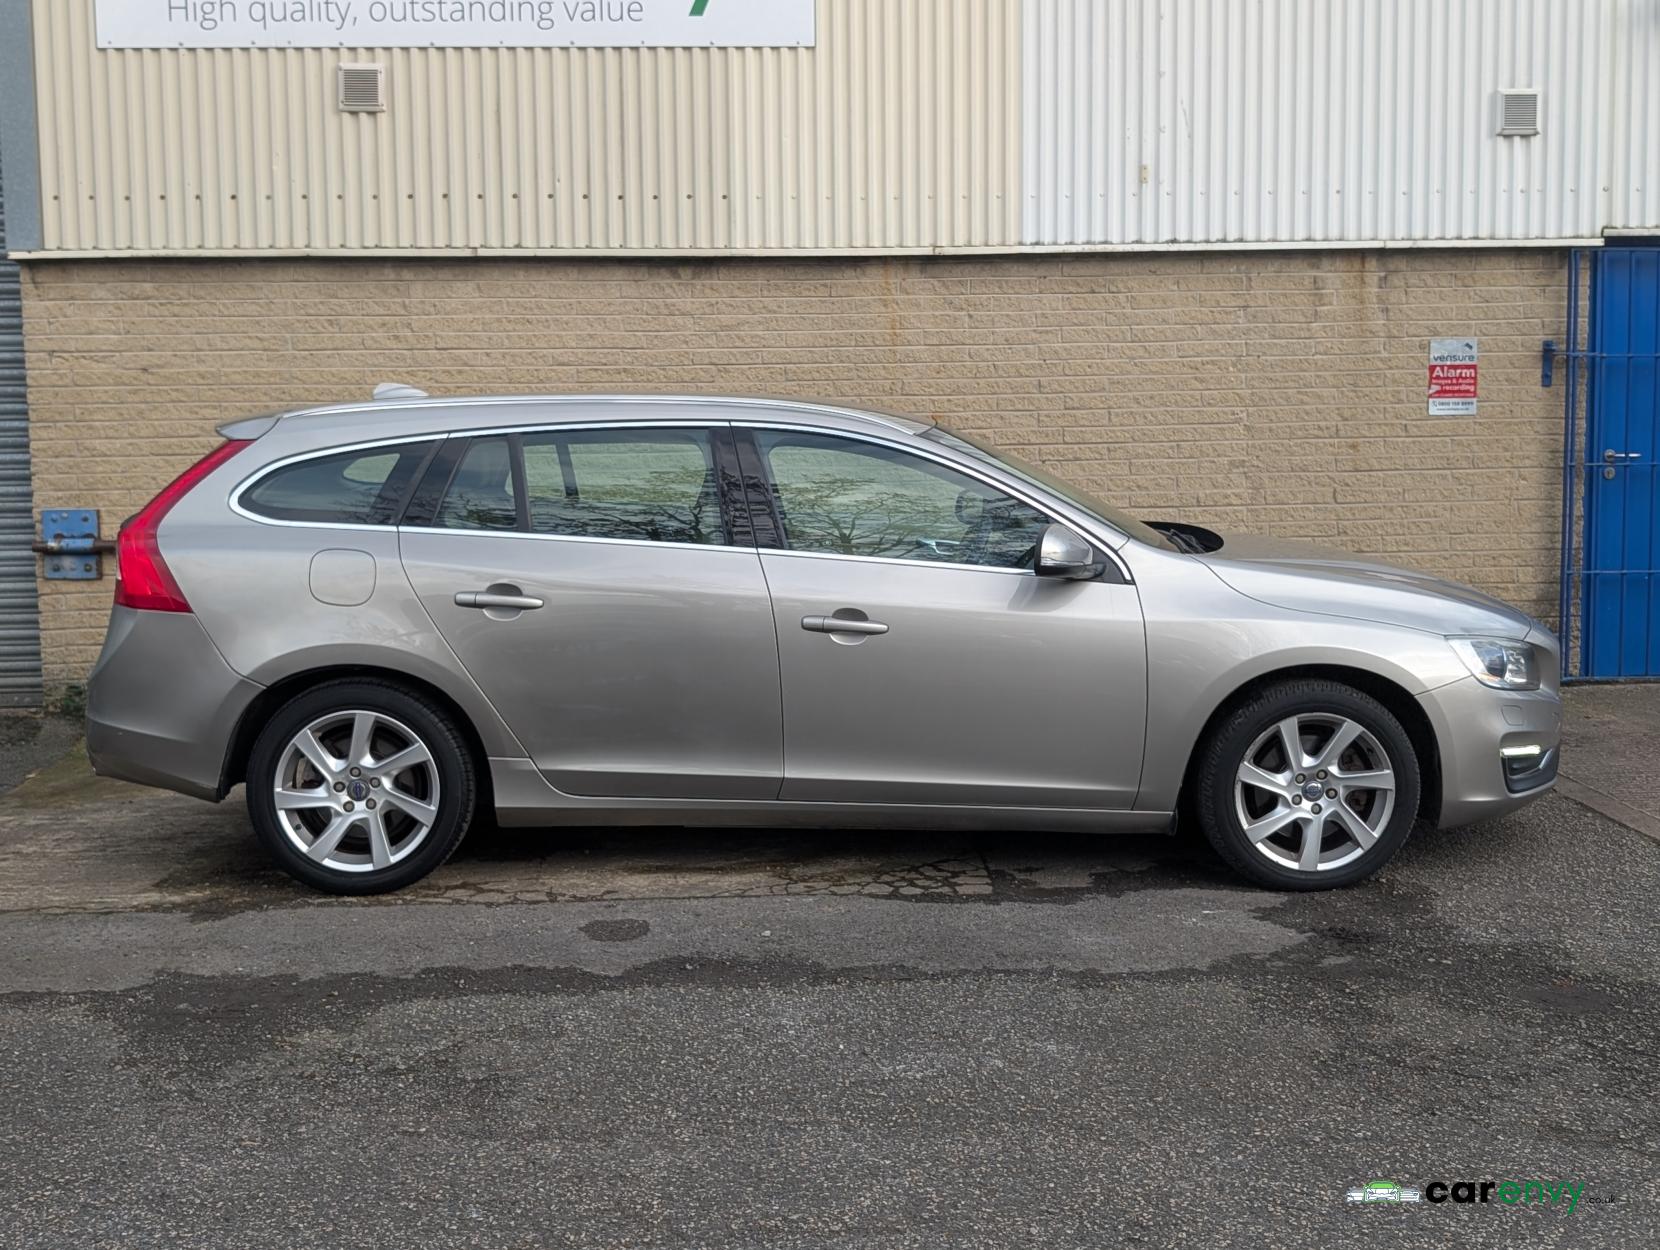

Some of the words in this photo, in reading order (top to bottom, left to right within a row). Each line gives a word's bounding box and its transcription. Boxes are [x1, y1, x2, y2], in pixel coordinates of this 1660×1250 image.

[168, 0, 237, 30] High
[248, 0, 358, 31] quality,
[369, 0, 555, 30] outstanding
[564, 0, 644, 23] value
[1432, 366, 1475, 378] Alarm
[1443, 384, 1475, 392] recording
